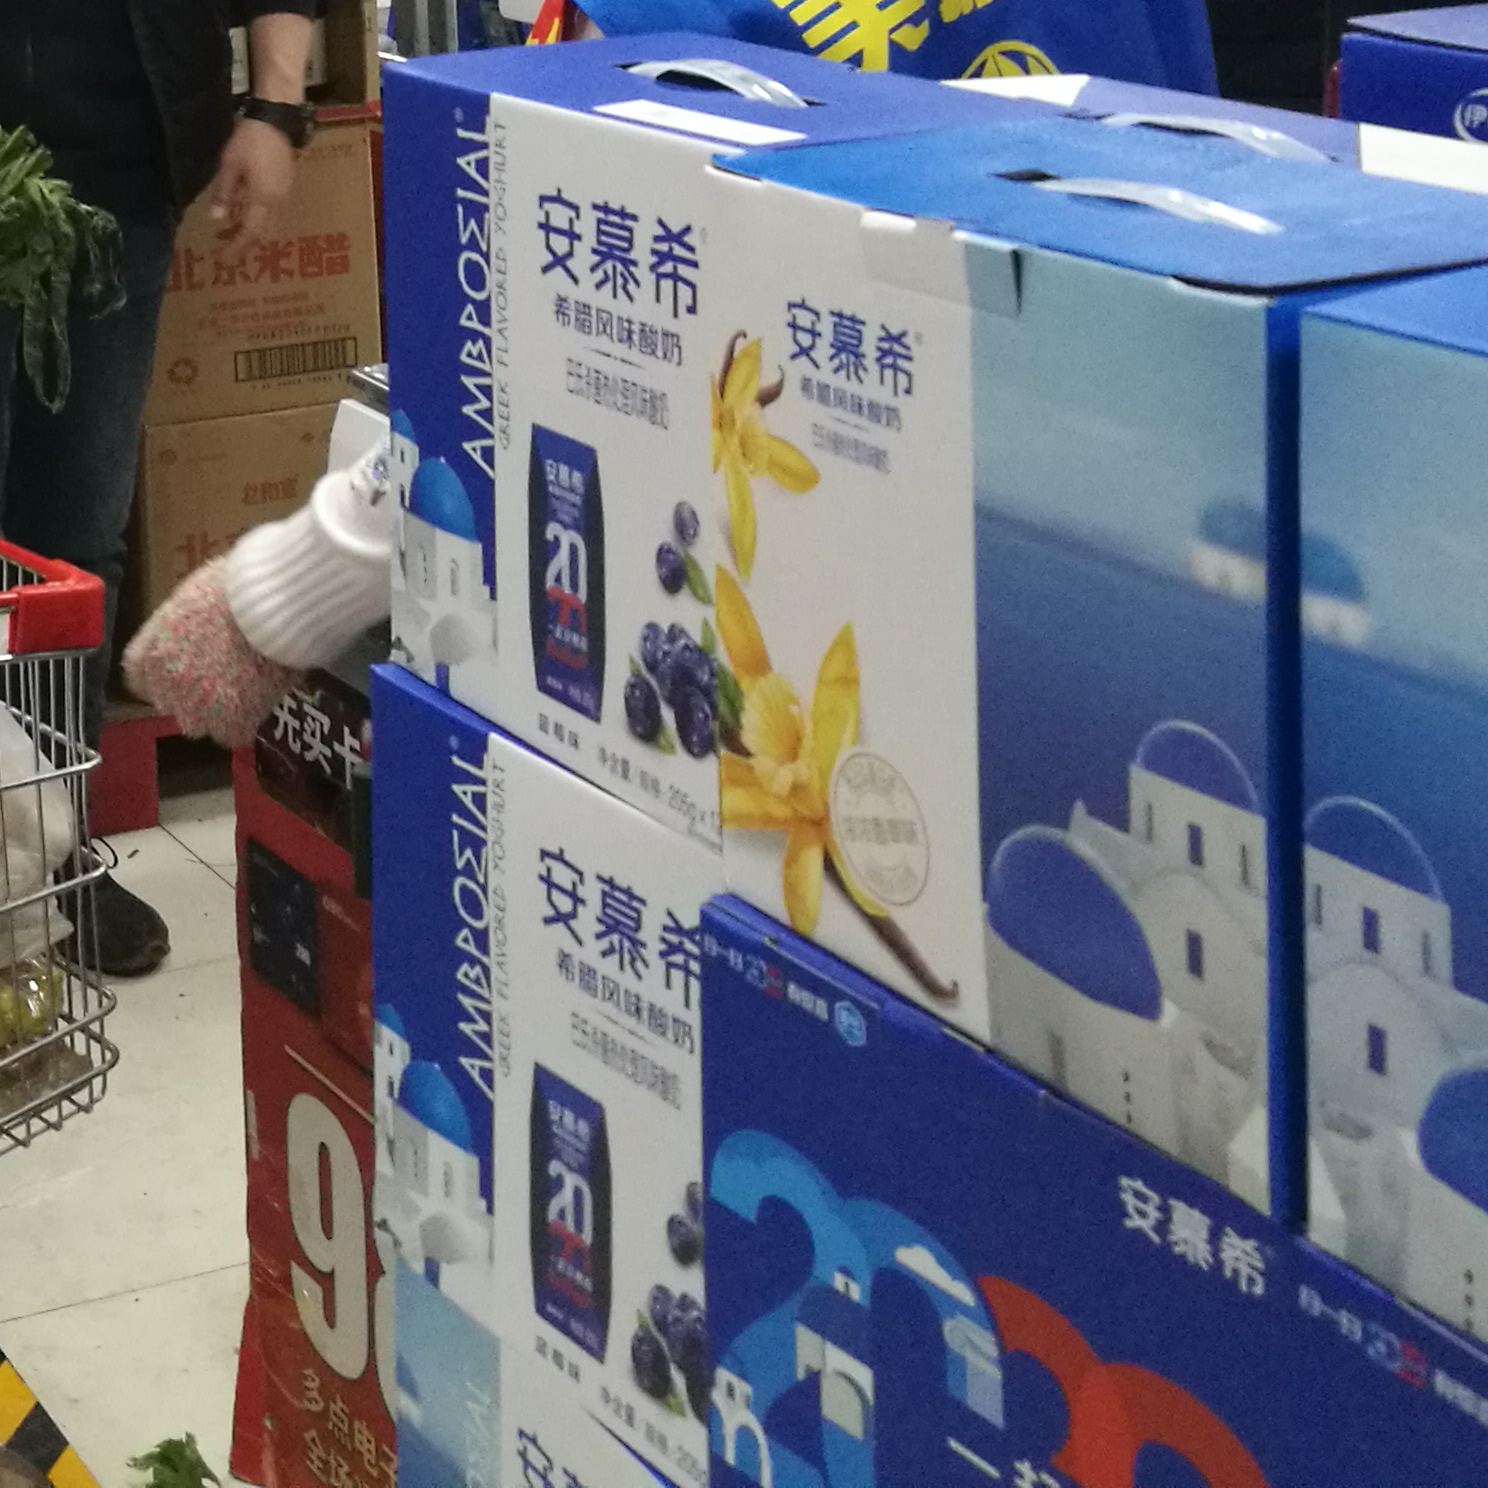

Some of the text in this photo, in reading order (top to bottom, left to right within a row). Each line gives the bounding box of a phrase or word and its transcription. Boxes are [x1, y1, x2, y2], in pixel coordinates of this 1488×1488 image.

[537, 187, 700, 320] 安慕希
[554, 291, 683, 367] 希腊风味酸奶
[787, 296, 914, 398] 安慕希
[538, 846, 701, 1010] 安慕希
[1118, 1176, 1266, 1297] 安慕希
